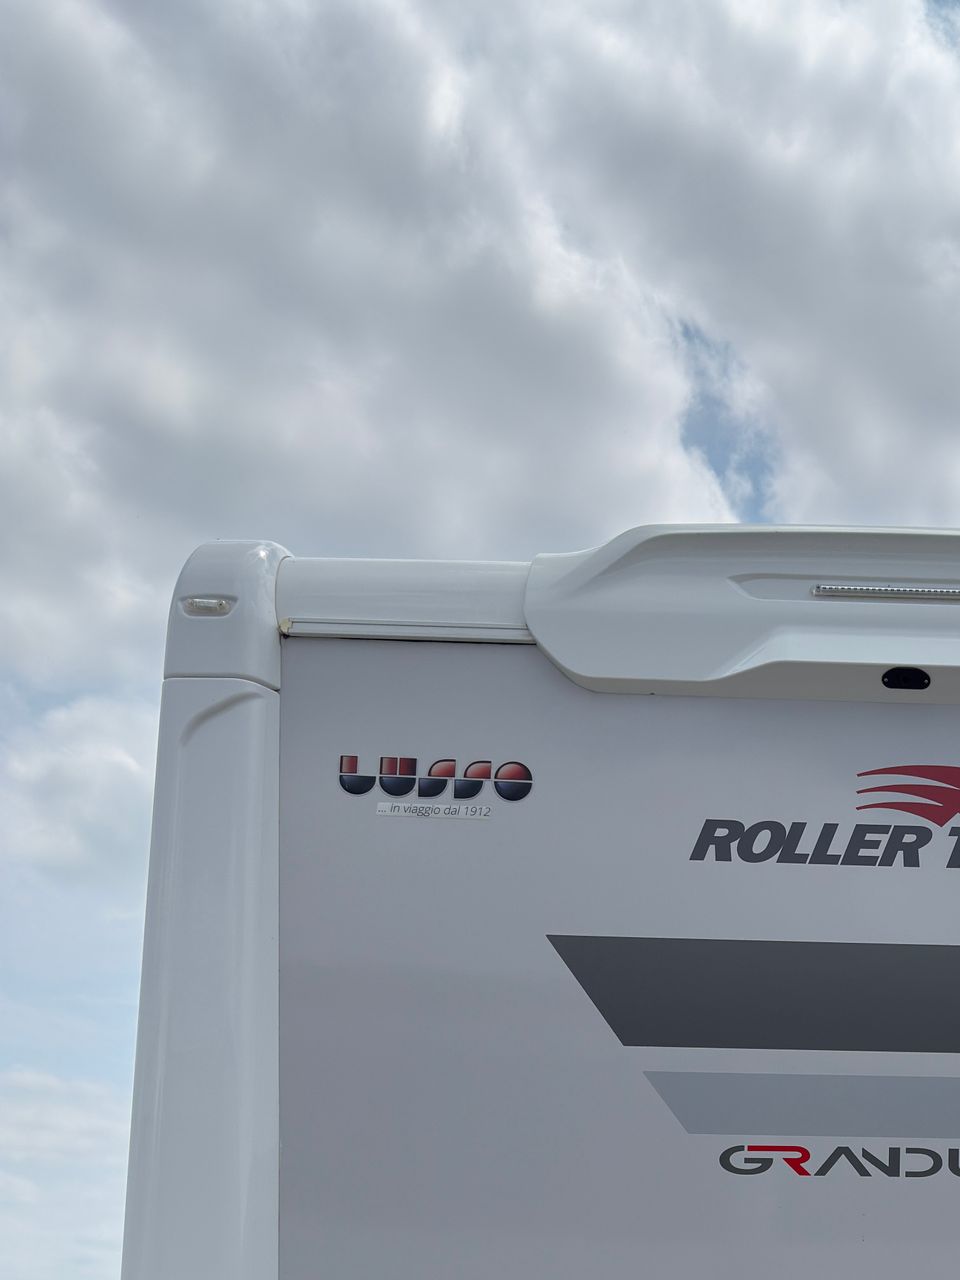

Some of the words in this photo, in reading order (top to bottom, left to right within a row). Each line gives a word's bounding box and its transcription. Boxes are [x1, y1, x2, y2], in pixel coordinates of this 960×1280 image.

[339, 755, 533, 801] LUSSO
[390, 803, 400, 813] in
[403, 804, 440, 816] viaggio
[444, 805, 460, 815] dal
[464, 806, 491, 817] 1912
[689, 818, 932, 868] ROLLER
